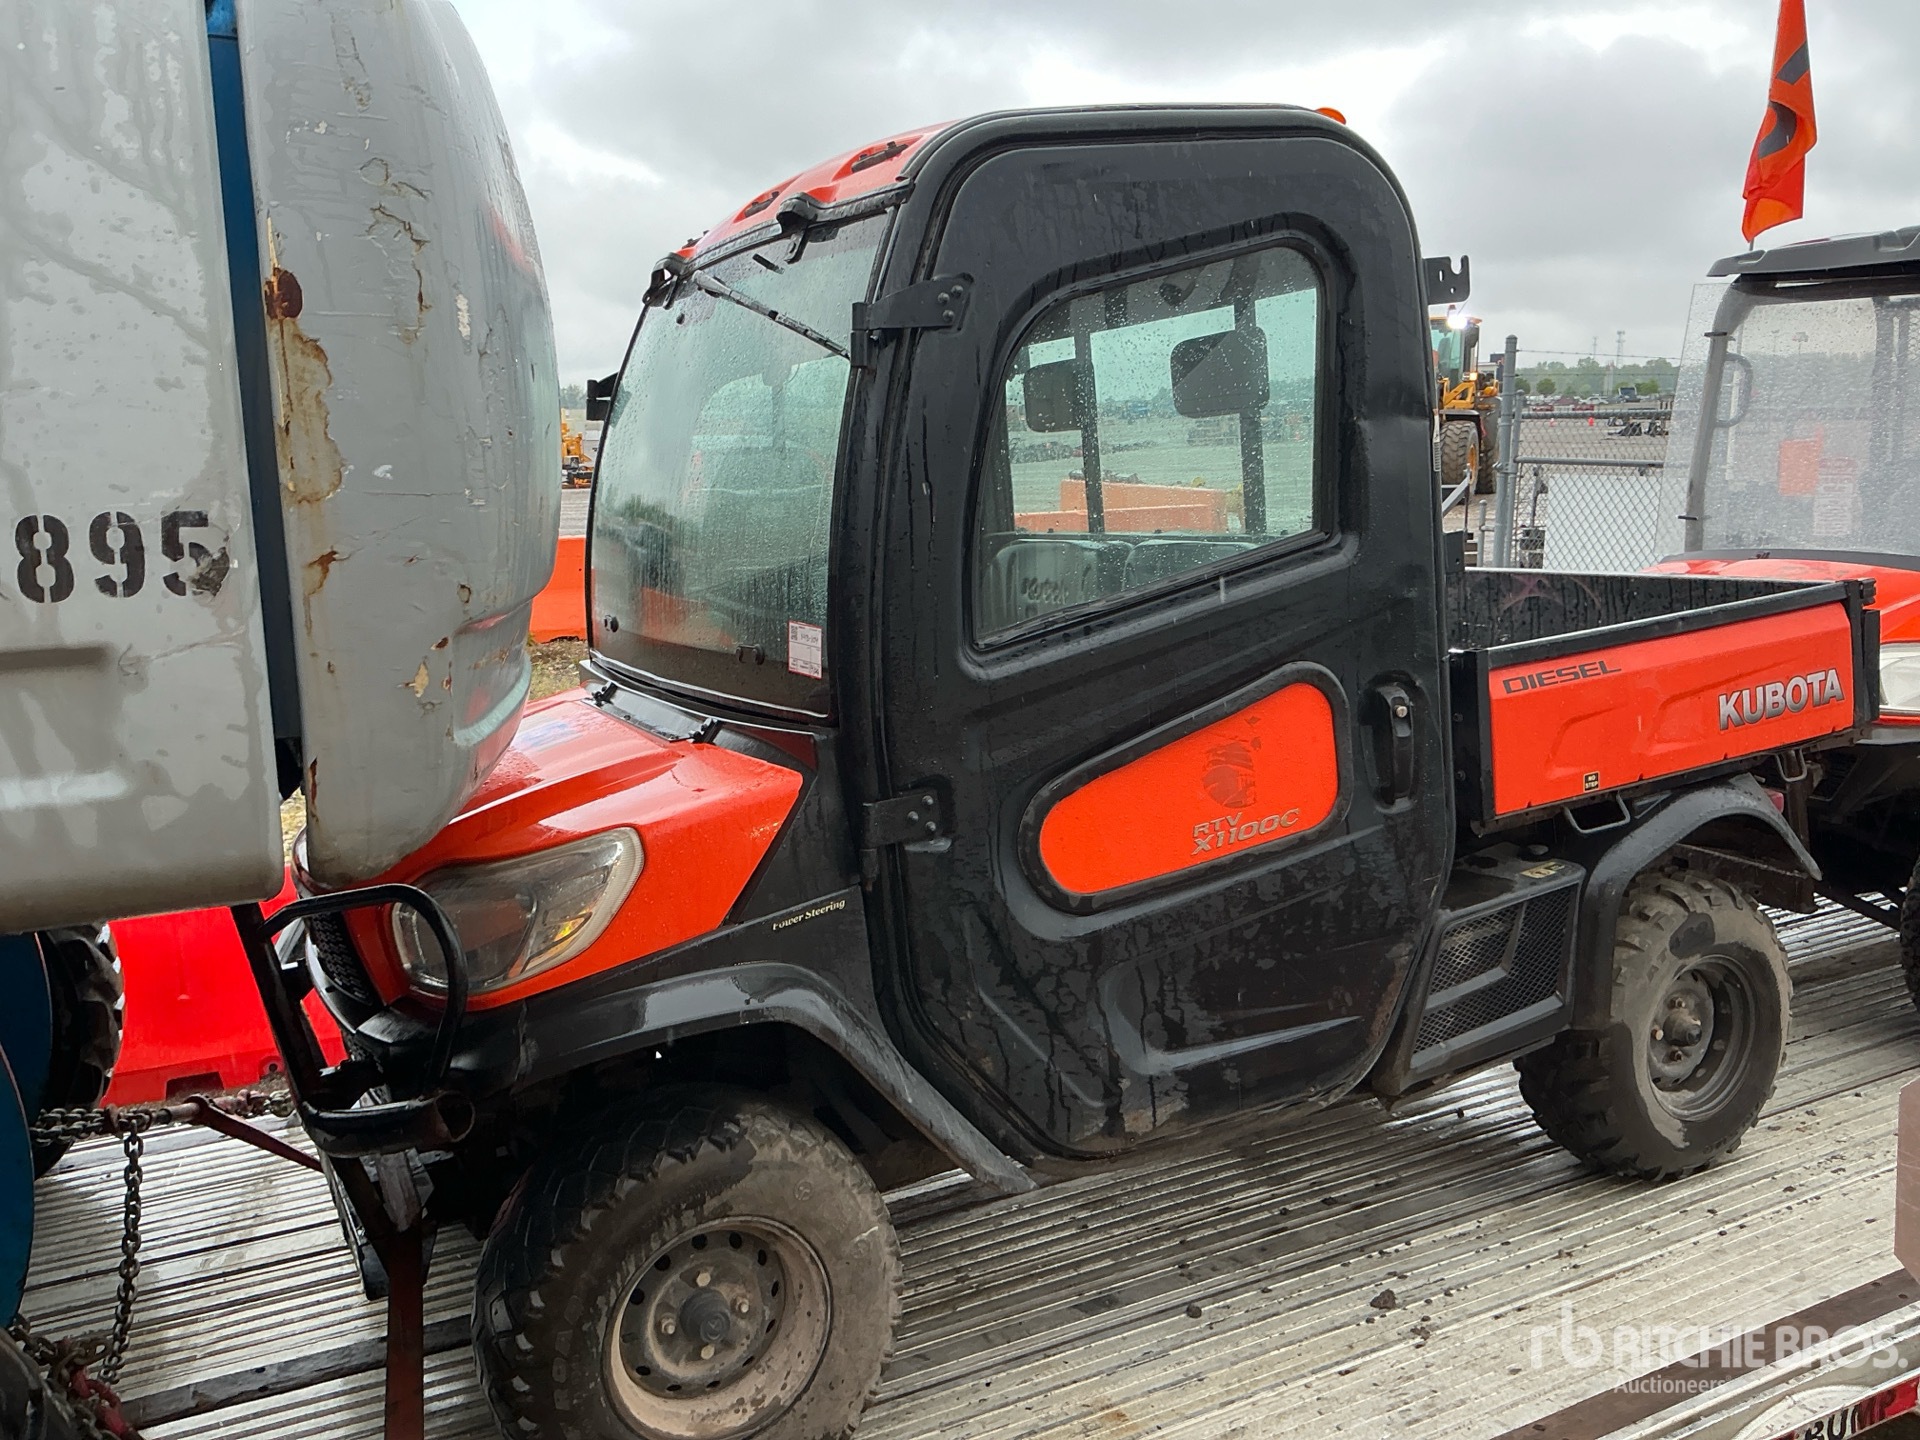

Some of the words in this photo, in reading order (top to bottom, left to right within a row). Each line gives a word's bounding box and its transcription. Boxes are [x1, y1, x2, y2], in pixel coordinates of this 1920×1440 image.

[15, 510, 230, 604] 895
[1502, 660, 1622, 695] DIESEL
[1718, 668, 1845, 731] KUBOTA
[1190, 808, 1300, 856] X1100C
[1193, 811, 1243, 838] RTV
[772, 913, 804, 931] Power
[804, 899, 846, 920] Steering
